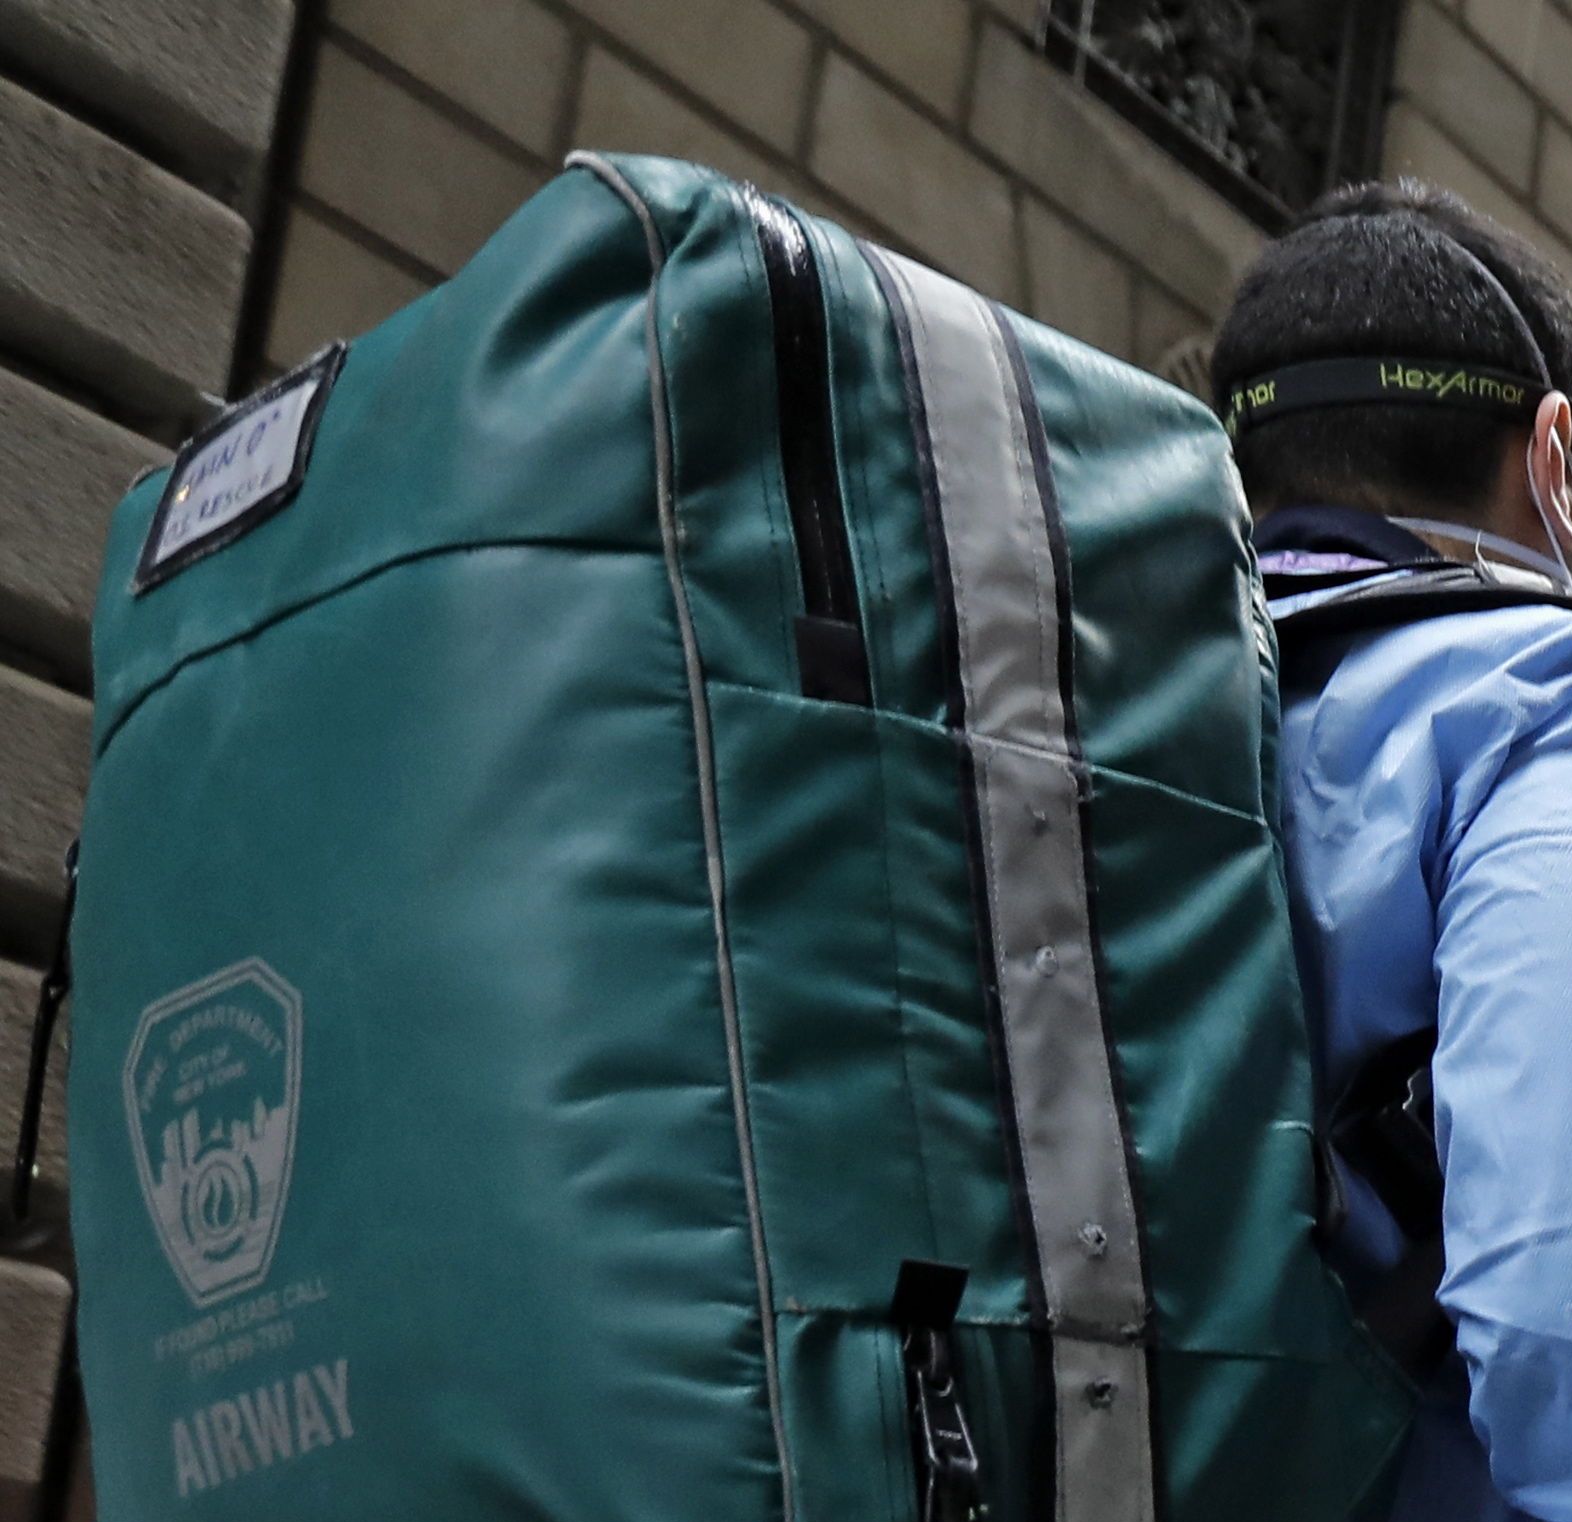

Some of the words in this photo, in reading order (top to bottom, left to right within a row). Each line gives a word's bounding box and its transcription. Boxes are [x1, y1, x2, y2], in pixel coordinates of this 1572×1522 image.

[1379, 362, 1525, 405] HexArmor
[170, 1004, 282, 1058] DEPARTMENT
[172, 1358, 353, 1498] AIRWAY
